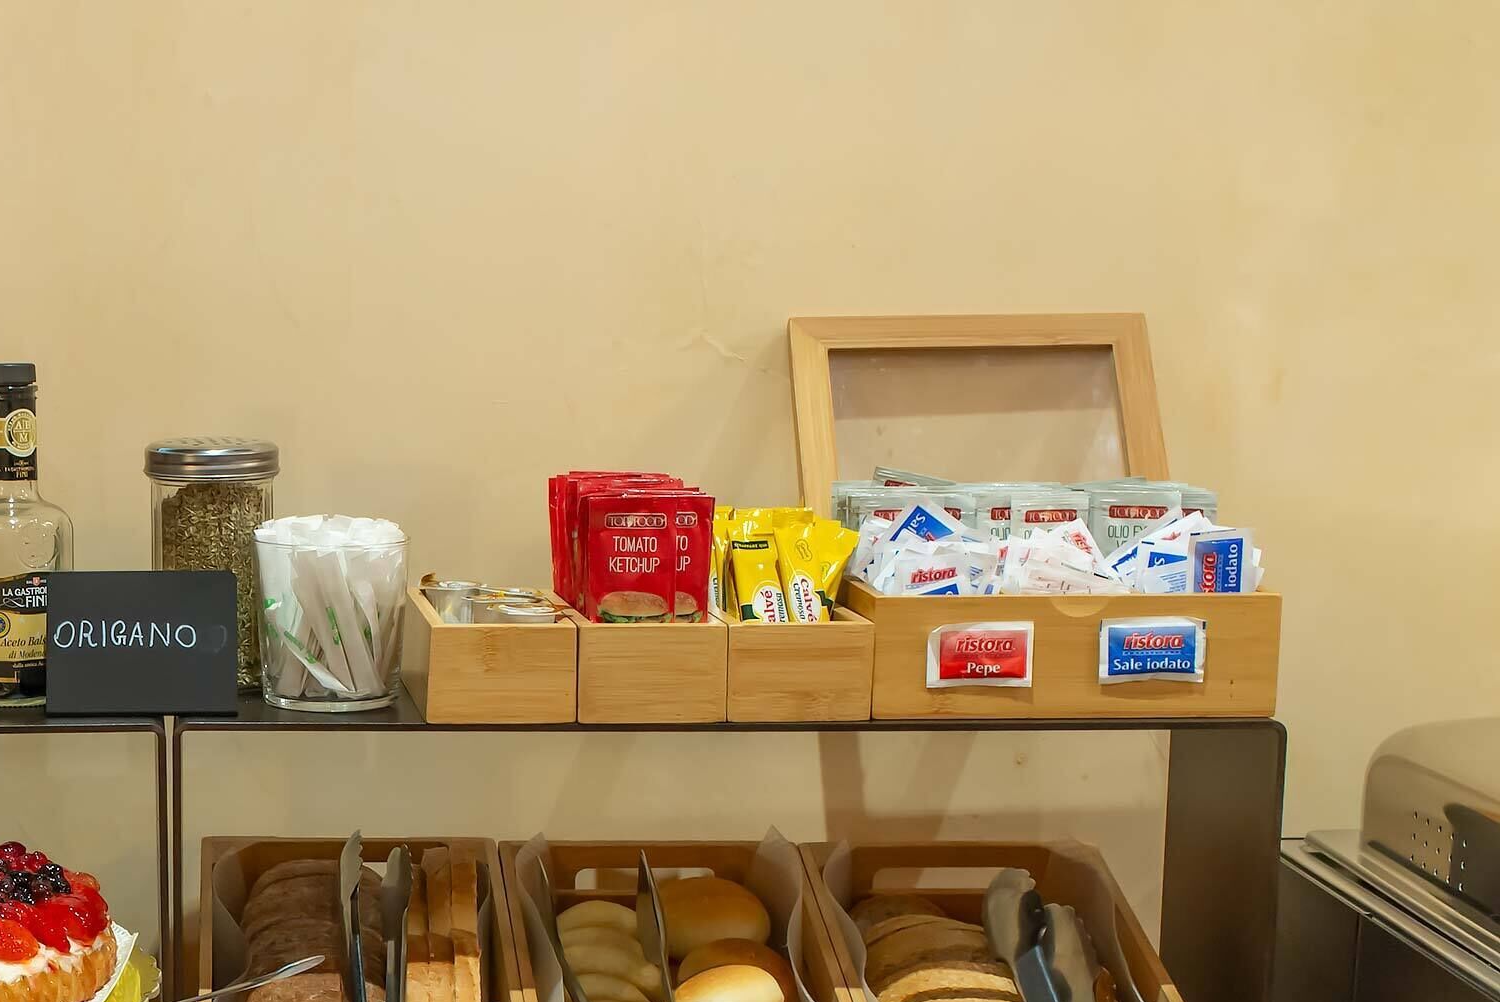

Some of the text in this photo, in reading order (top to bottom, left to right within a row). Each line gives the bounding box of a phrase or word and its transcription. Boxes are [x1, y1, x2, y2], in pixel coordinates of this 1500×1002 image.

[1107, 525, 1130, 539] OLIO
[612, 535, 658, 553] TOMATO
[609, 556, 661, 573] KETCHUP
[911, 567, 958, 584] ristora
[2, 586, 48, 597] LA GASTRO
[53, 619, 198, 649] ORIGANO
[1123, 632, 1184, 650] ristora
[956, 636, 1016, 652] ristora
[966, 662, 1001, 677] Pepe
[1113, 657, 1192, 671] Sale iodato
